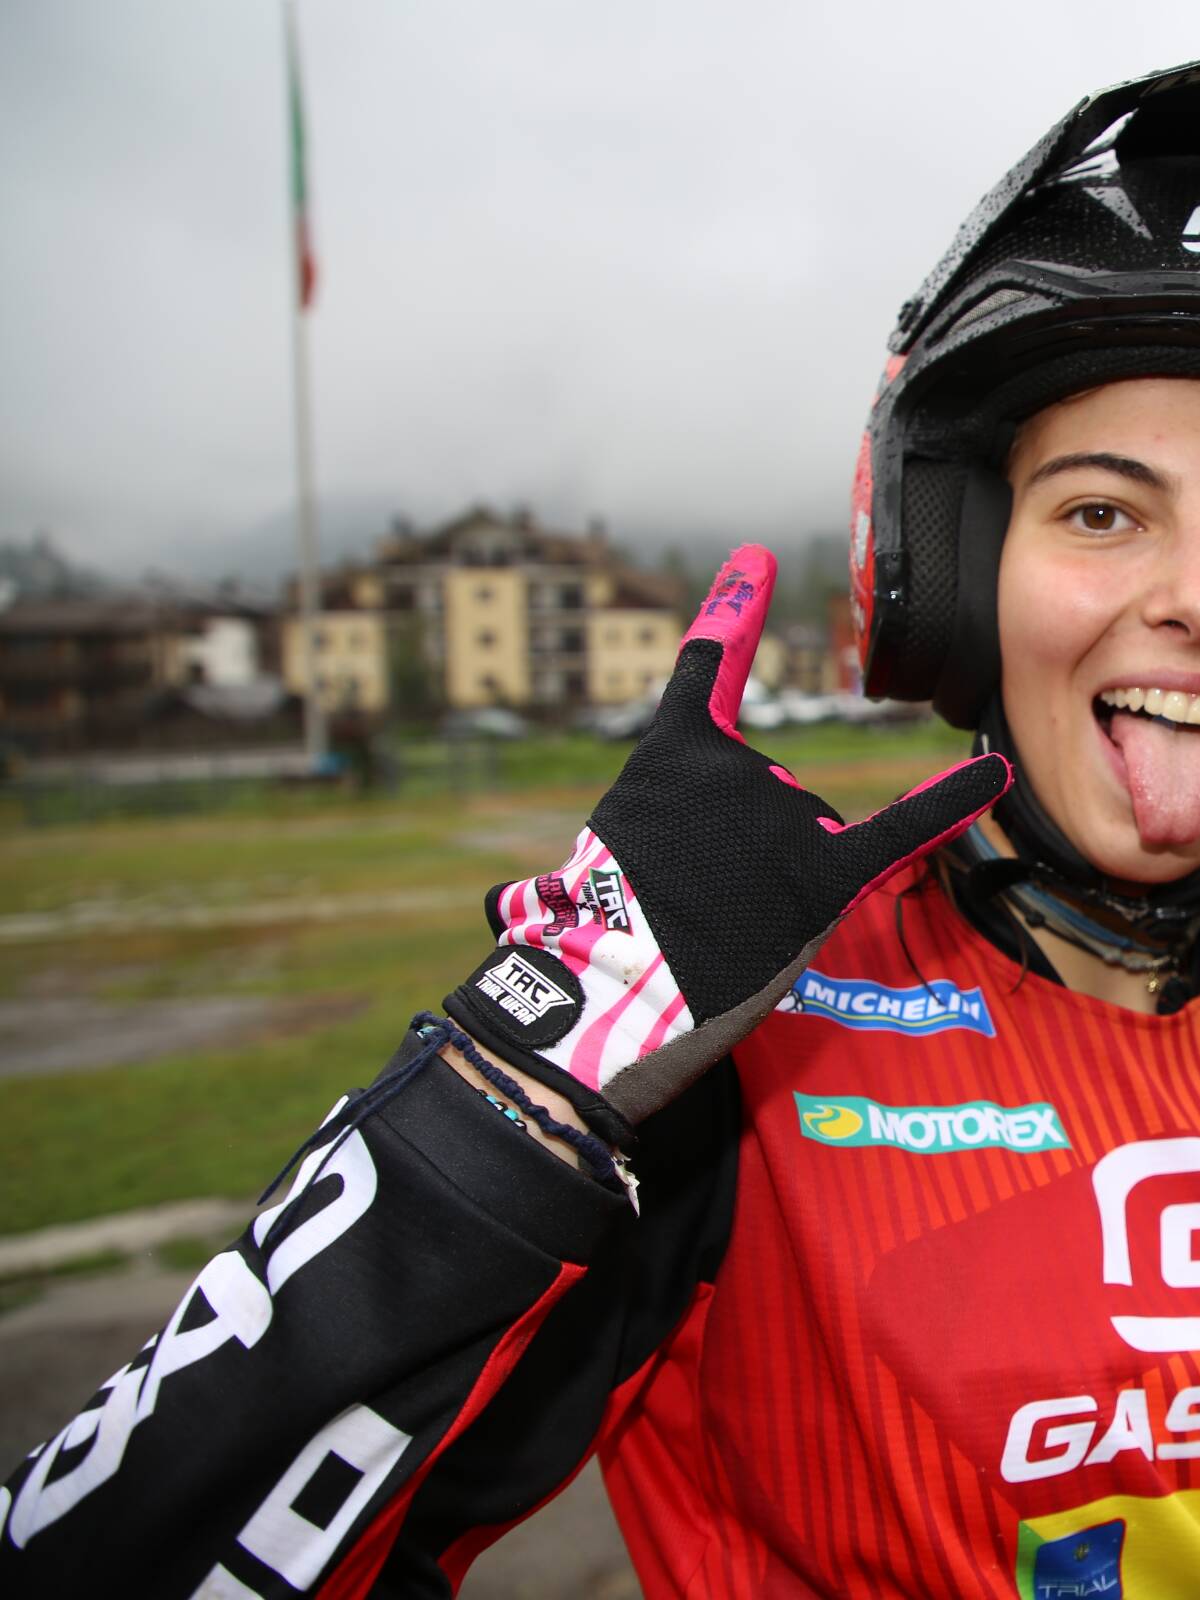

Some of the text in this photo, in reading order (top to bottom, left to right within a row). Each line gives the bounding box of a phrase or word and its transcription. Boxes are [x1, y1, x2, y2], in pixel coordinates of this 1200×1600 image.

[475, 976, 537, 1026] TRIAL WEAR
[505, 962, 550, 1004] TAC
[804, 979, 981, 1021] MICHELIN
[867, 1103, 1064, 1149] MOTOREX
[1038, 1574, 1118, 1600] TRIAL
